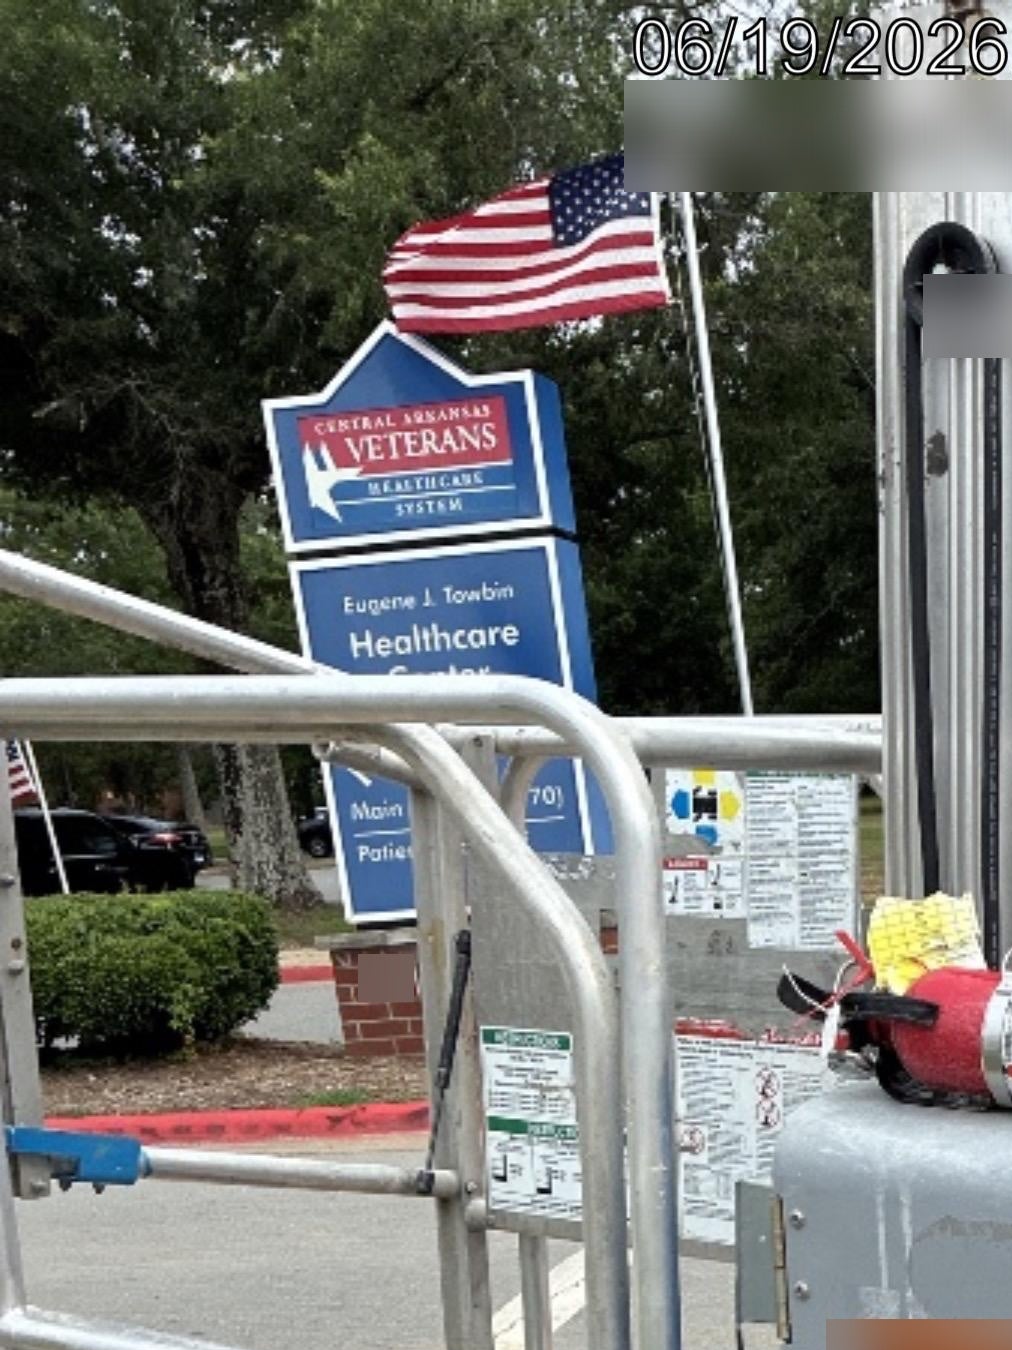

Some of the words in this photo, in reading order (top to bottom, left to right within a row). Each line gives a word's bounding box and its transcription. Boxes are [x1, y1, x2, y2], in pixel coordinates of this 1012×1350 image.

[314, 412, 396, 435] CENTRAL
[403, 403, 492, 426] ARKANSAS
[344, 422, 497, 464] VETERANS
[368, 471, 484, 494] HEALTHCARE
[395, 497, 464, 517] SYSTEM
[343, 595, 415, 616] Eugene
[443, 582, 515, 605] Towbin
[349, 623, 521, 659] Healthcare
[350, 798, 403, 820] Main
[528, 784, 565, 810] 70)
[358, 841, 414, 863] Patie
